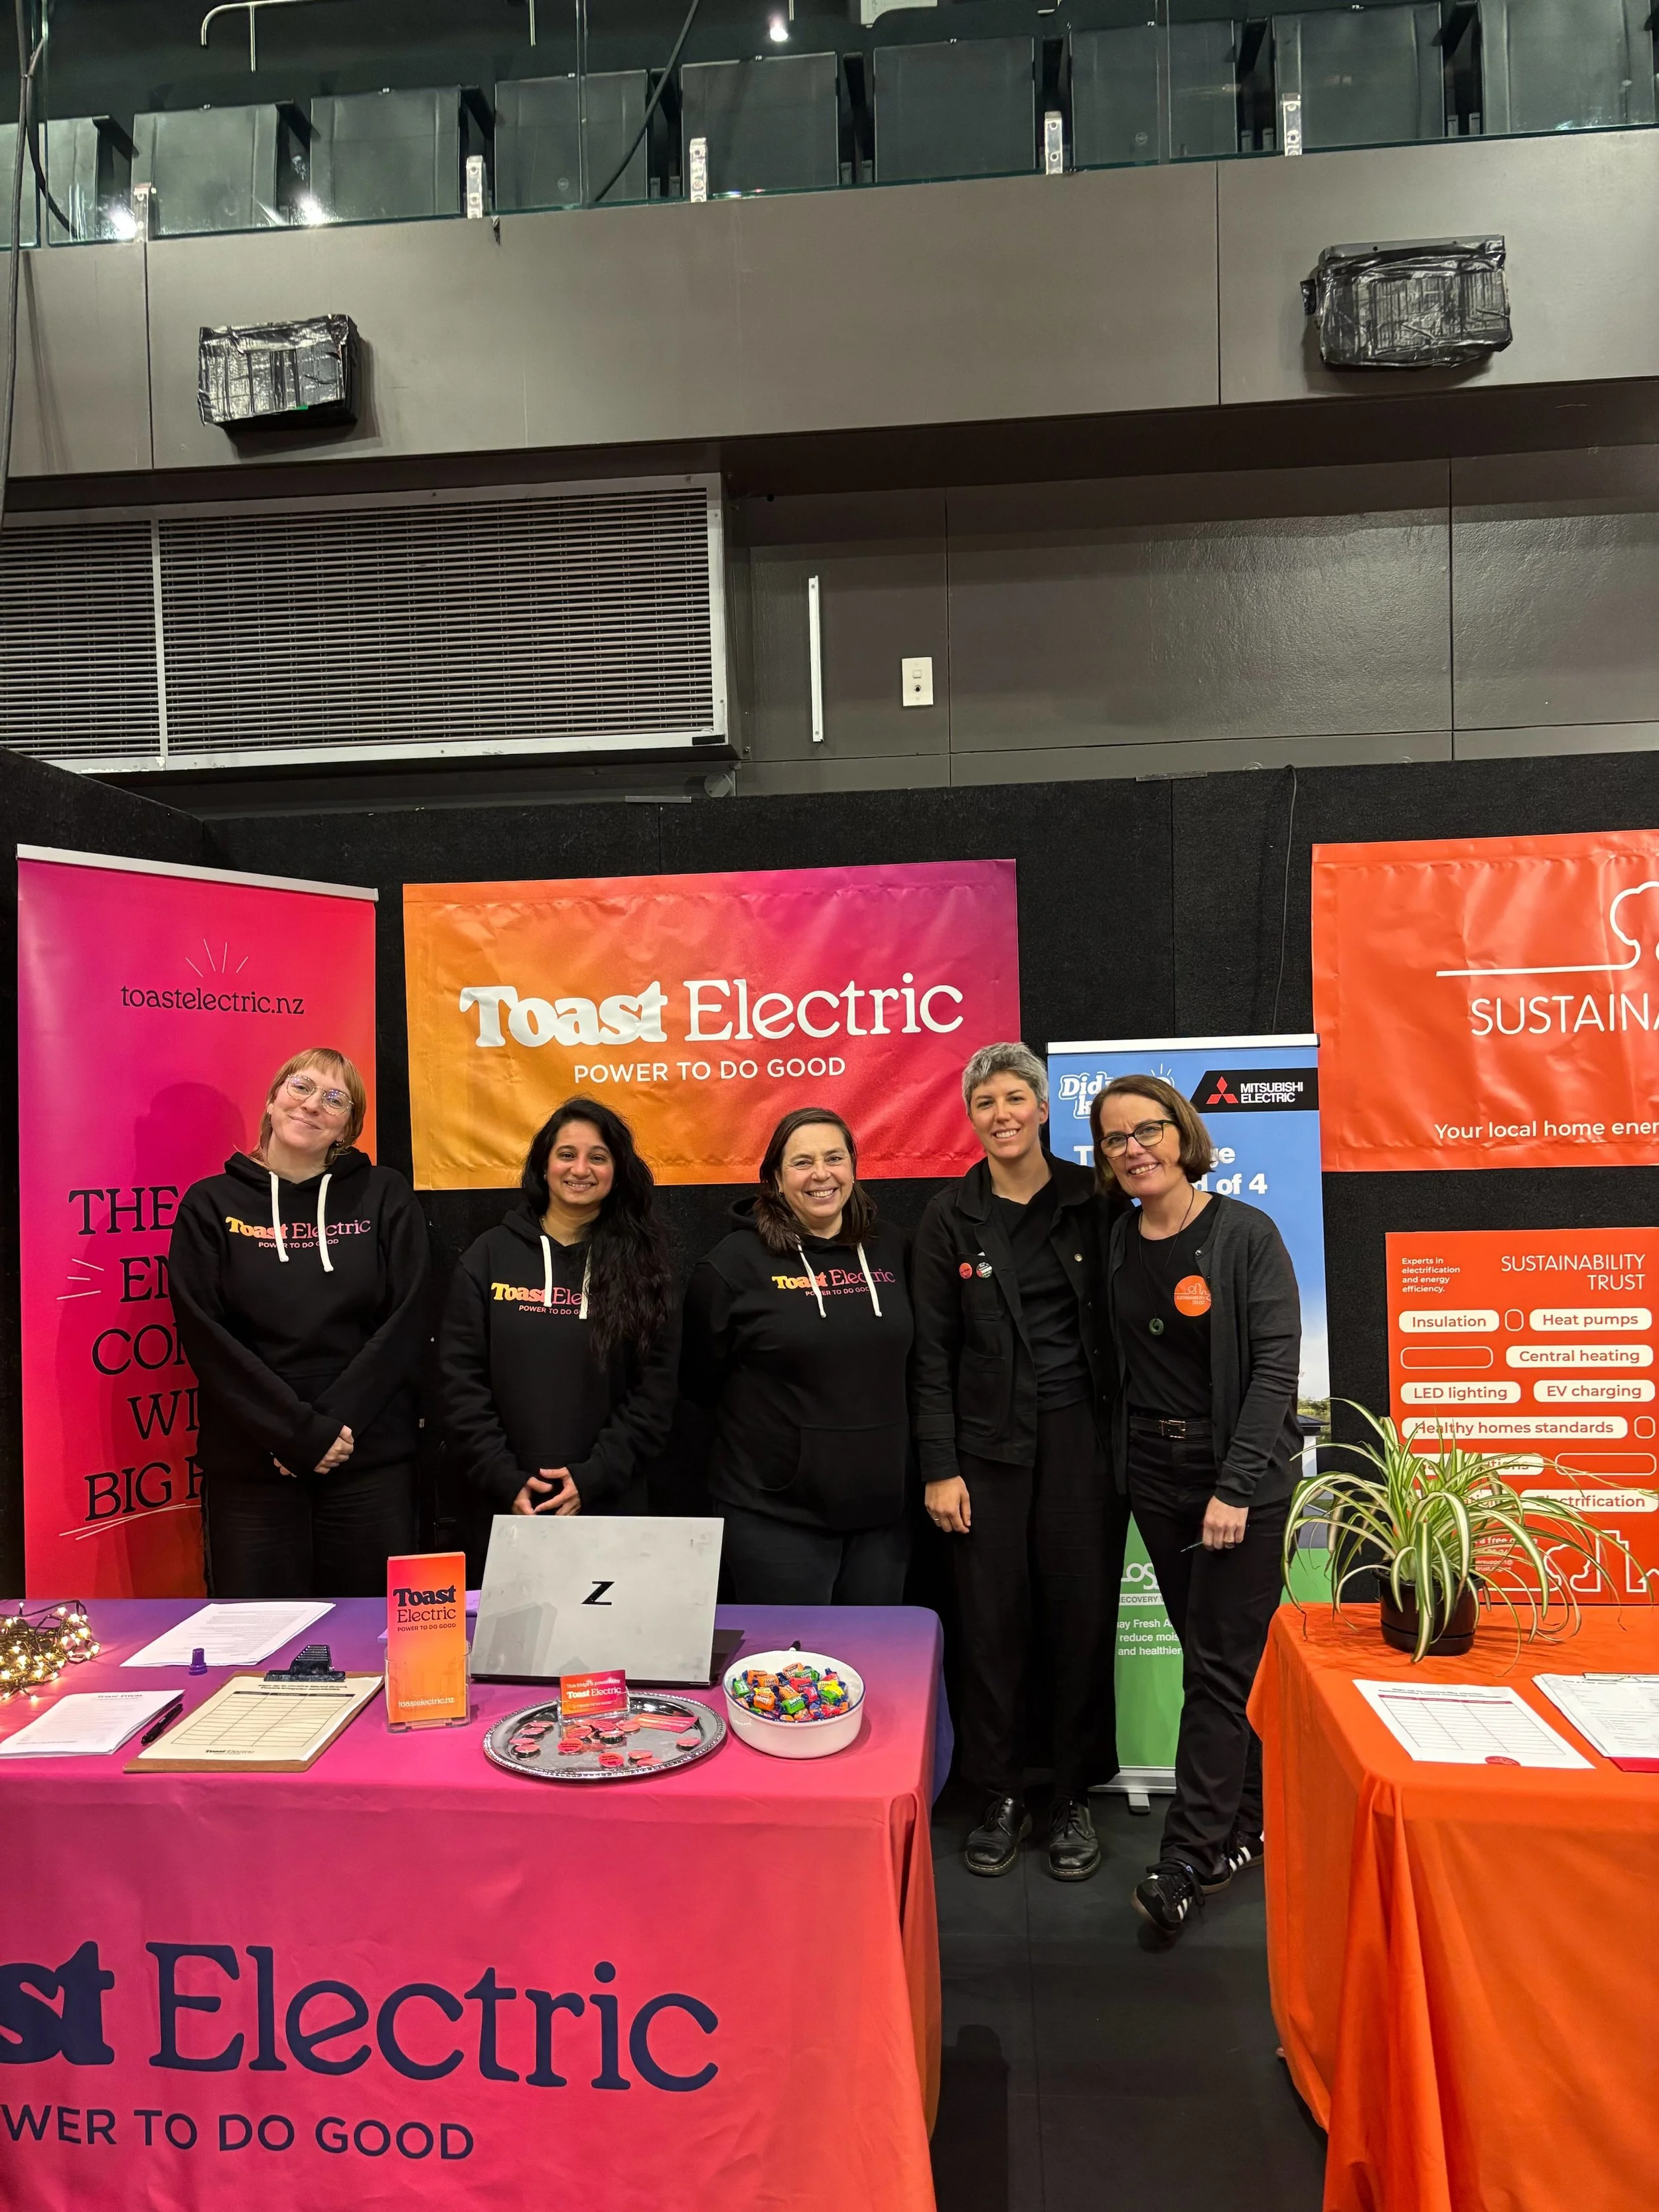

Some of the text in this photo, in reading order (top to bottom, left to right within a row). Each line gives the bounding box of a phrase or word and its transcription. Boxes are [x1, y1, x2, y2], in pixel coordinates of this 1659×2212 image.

[120, 985, 305, 1015] toastelectric.nz
[458, 972, 964, 1047] Toast Electric
[1471, 992, 1659, 1036] SUSTAIN
[574, 1057, 846, 1084] POWER TO DO GOOD
[1240, 1081, 1304, 1094] MITSUBISHI
[1240, 1092, 1296, 1104] ELECTRIC
[1434, 1123, 1483, 1139] Your
[1488, 1120, 1537, 1138] local
[1544, 1120, 1605, 1137] home
[1216, 1173, 1242, 1195] of
[1248, 1173, 1268, 1195] 4
[68, 1185, 179, 1236] THE
[1402, 1257, 1433, 1266] Experts
[1500, 1253, 1646, 1272] SUSTAINABILITY
[1402, 1265, 1461, 1274] electrification
[1402, 1276, 1450, 1285] and energy
[1587, 1274, 1646, 1291] TRUST
[1402, 1285, 1445, 1293] efficiency.
[518, 1305, 547, 1314] POWER
[1411, 1315, 1487, 1328] Insulation
[1542, 1314, 1639, 1329] Heat pumps
[1519, 1349, 1640, 1364] Central heating
[1413, 1386, 1508, 1401] LED lighting
[1547, 1385, 1642, 1399] EV charging
[1415, 1421, 1614, 1436] Healthy homes standards
[84, 1461, 172, 1522] BIG
[393, 1584, 457, 1607] Toast
[581, 1581, 615, 1605] Z
[397, 1606, 457, 1623] Electric
[1133, 1619, 1161, 1628] Fresh
[1119, 1633, 1153, 1642] reduce
[1118, 1646, 1182, 1656] and healthier
[566, 1686, 622, 1700] Toast Electric
[398, 1696, 455, 1708] toastelectric.nz
[146, 1942, 719, 2093] Electric
[133, 2109, 197, 2150] TO
[218, 2113, 295, 2152] DO
[315, 2117, 474, 2160] GOOD
